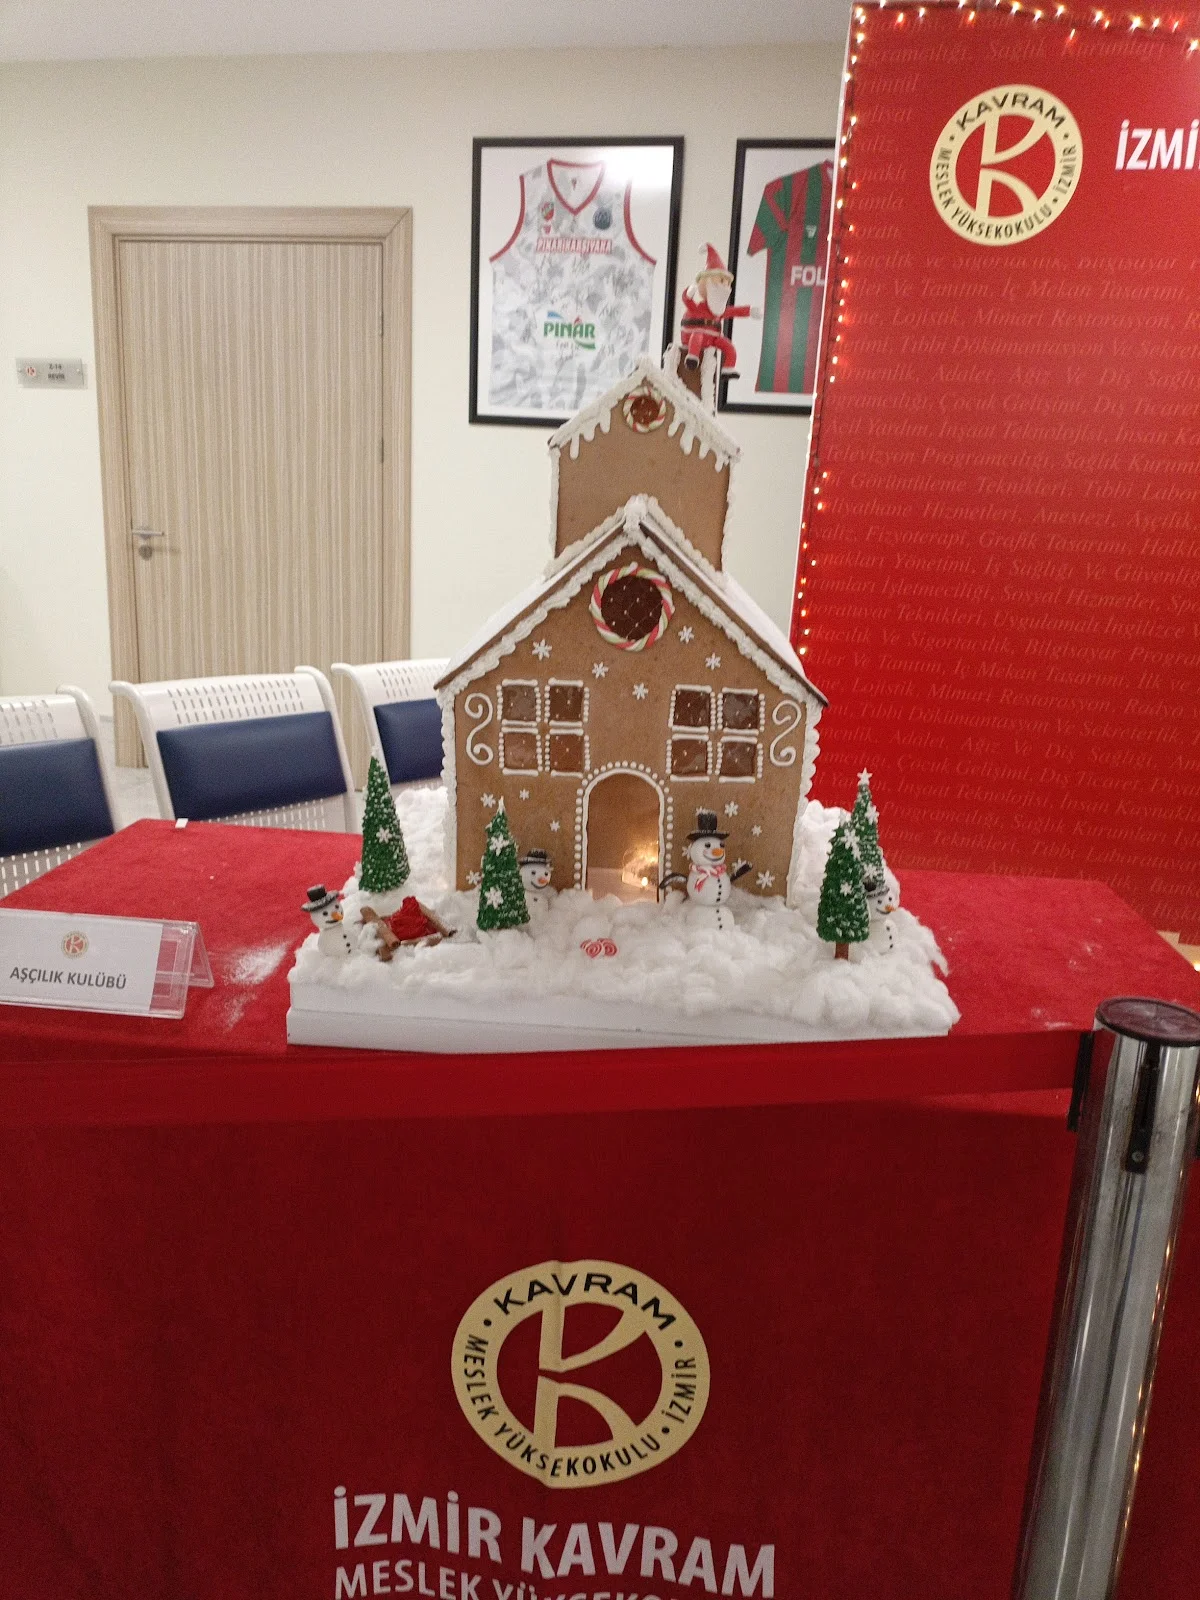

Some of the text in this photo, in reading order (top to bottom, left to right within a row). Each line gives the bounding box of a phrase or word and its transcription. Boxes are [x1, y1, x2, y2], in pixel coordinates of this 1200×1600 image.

[955, 92, 1067, 132] KAVRAM
[936, 147, 956, 209] MESLEK
[951, 203, 1051, 240] YÜKSEKOKULU
[1052, 144, 1076, 195] İZMİR
[543, 321, 596, 338] PINAR
[9, 966, 127, 990] AŞÇILIK KULÜBÜ
[493, 1272, 677, 1331] KAVRAM
[463, 1333, 661, 1477] MESLEK YÜKSEKOKULU
[661, 1356, 697, 1424] İZMİR
[333, 1485, 775, 1599] İZMİR KAVRAM
